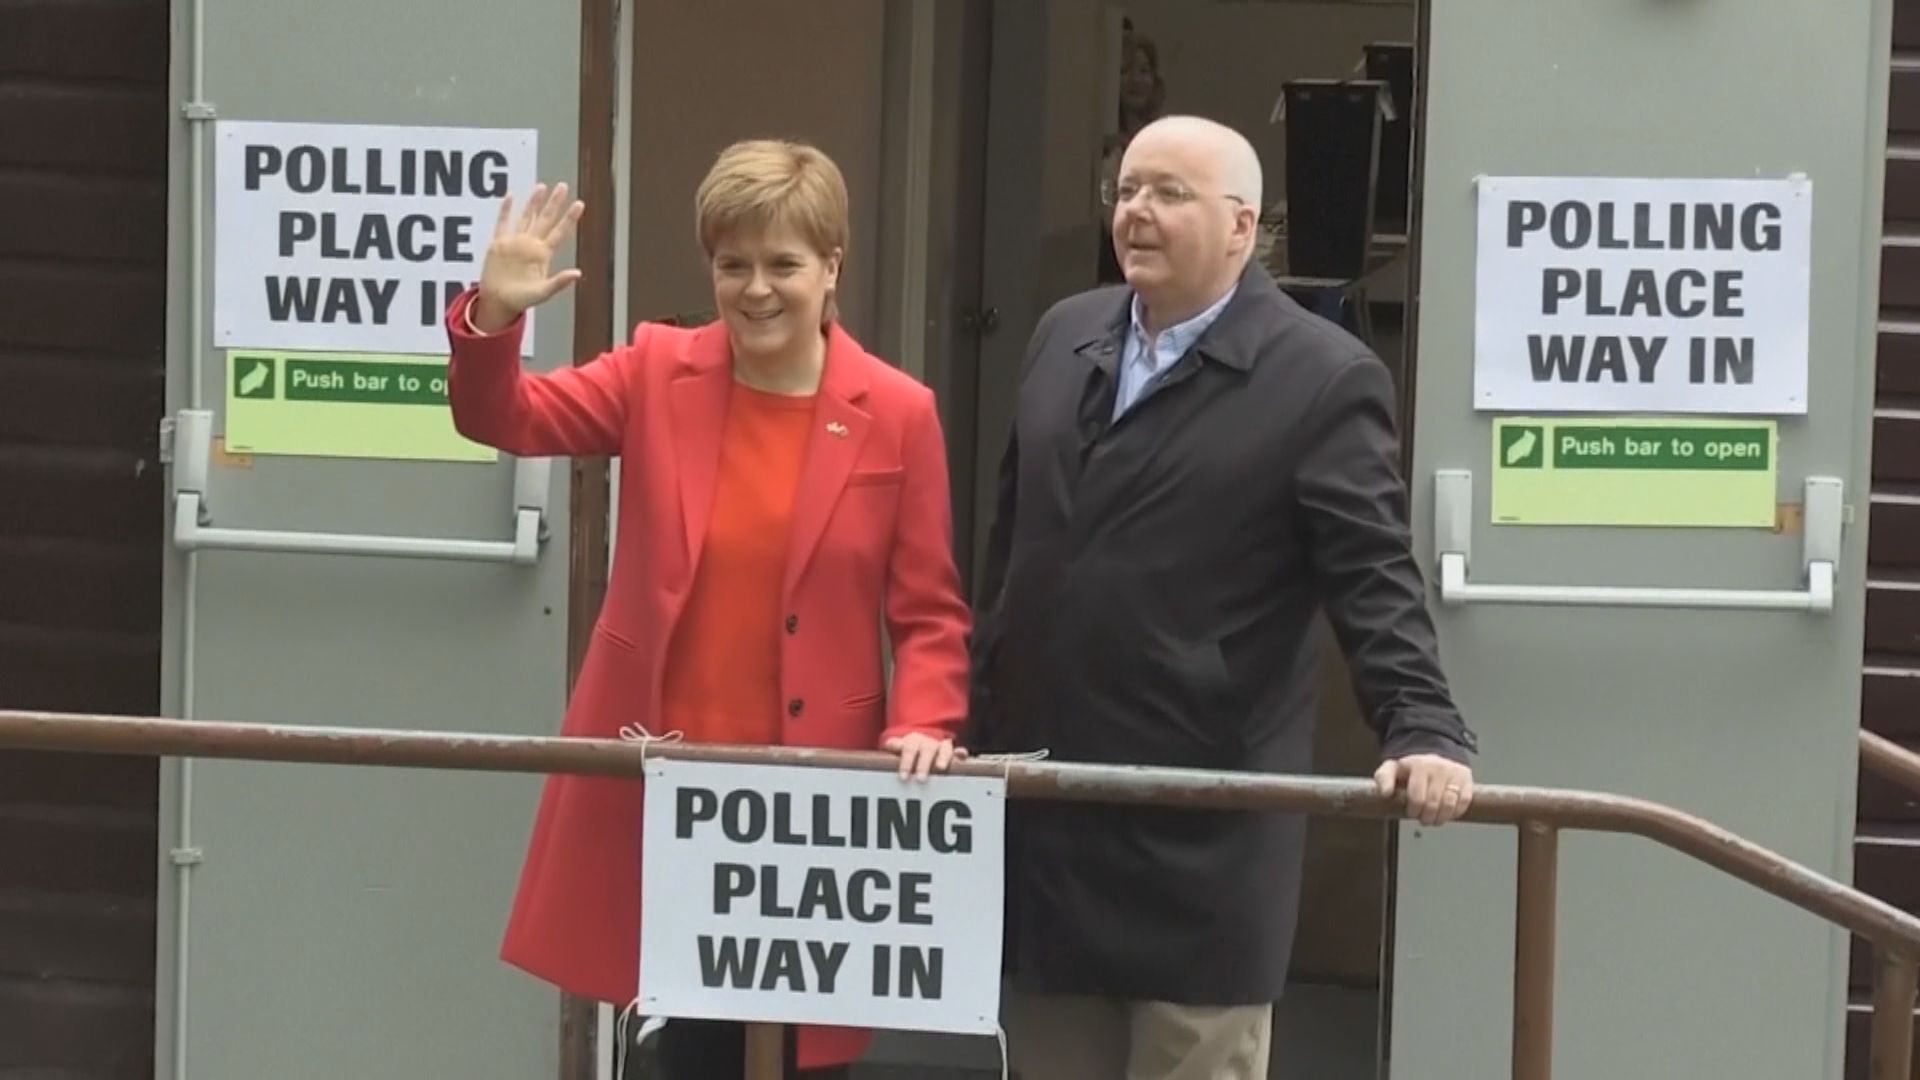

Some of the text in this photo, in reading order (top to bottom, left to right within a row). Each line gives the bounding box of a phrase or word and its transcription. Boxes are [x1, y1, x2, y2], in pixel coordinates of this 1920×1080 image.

[244, 144, 509, 198] POLLING
[278, 210, 474, 263] PLACE
[1506, 200, 1782, 252] POLLING
[264, 275, 400, 326] WAY
[1541, 267, 1745, 318] PLACE
[292, 369, 344, 390] Push
[353, 371, 389, 391] bar
[398, 373, 421, 392] to
[1527, 334, 1754, 385] WAY IN
[1561, 435, 1762, 461] Push bar to open
[675, 786, 973, 854] POLLING
[713, 861, 934, 926] PLACE
[696, 934, 944, 1000] WAY IN
